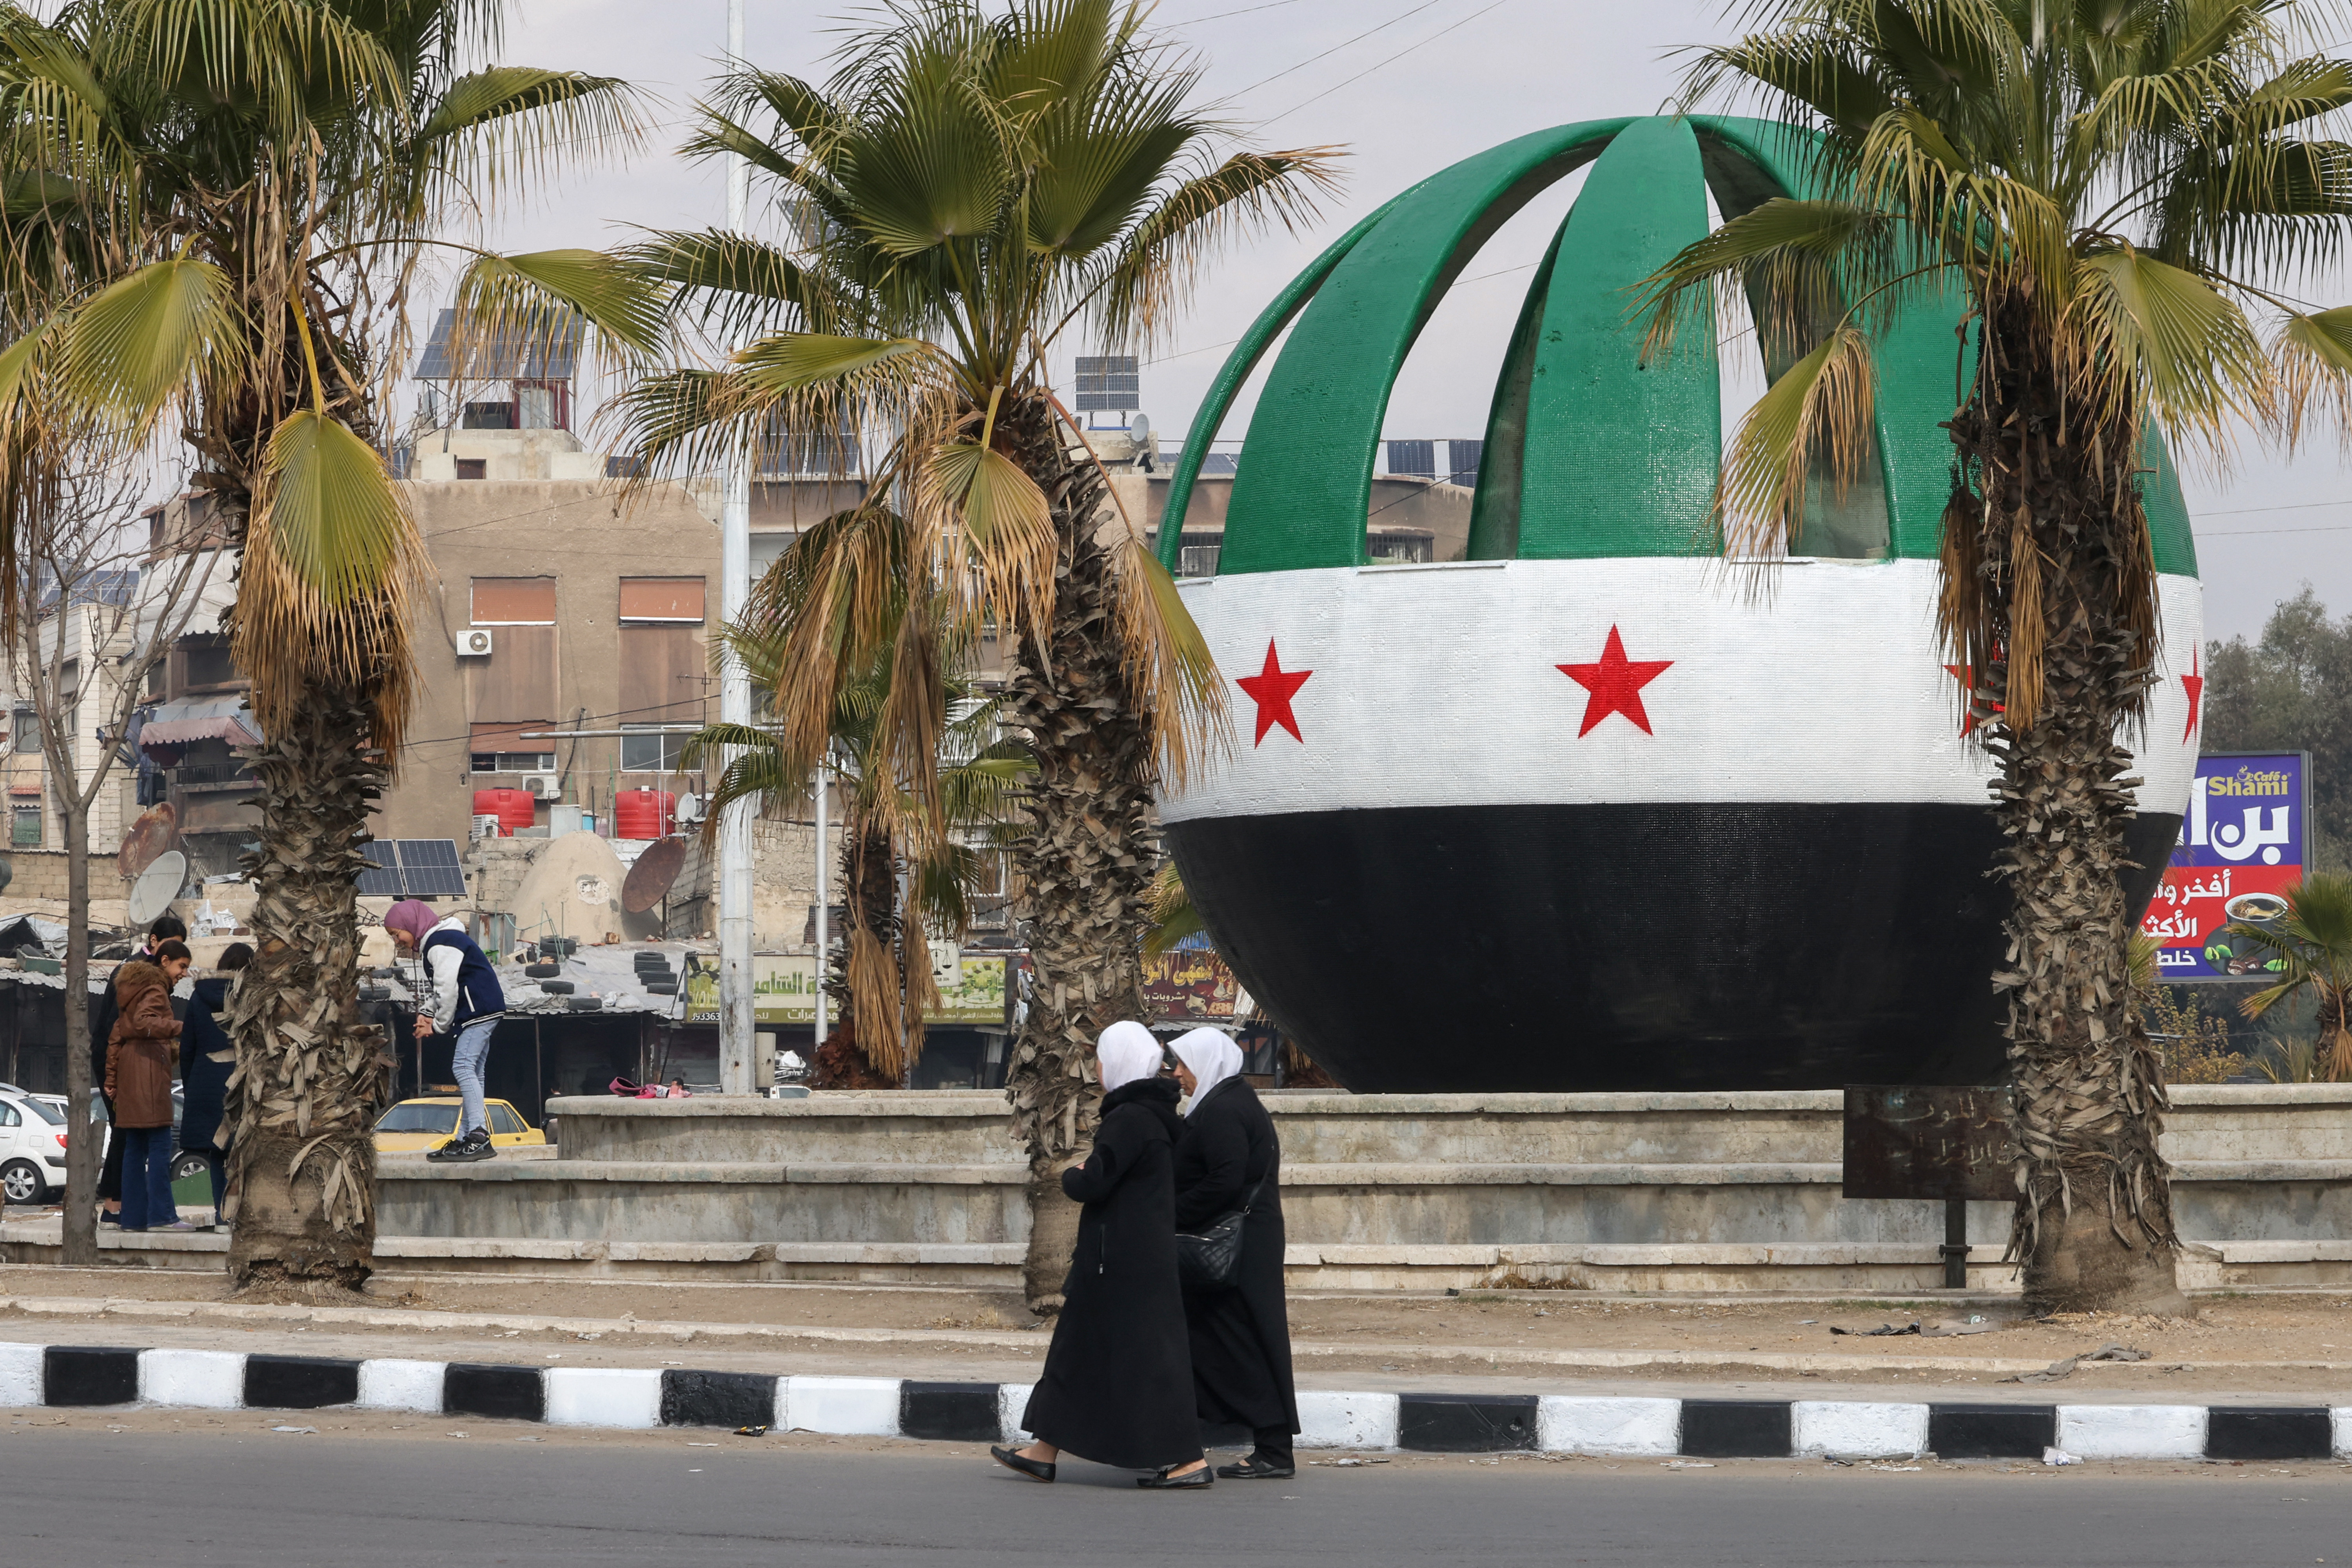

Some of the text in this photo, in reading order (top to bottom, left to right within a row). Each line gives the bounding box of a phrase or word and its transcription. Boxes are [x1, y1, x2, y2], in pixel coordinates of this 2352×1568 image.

[2208, 774, 2288, 796] Shami
[2254, 771, 2281, 782] Café
[2211, 805, 2290, 865] بن
[2180, 868, 2232, 906] أفخر
[2149, 950, 2197, 966] خلط
